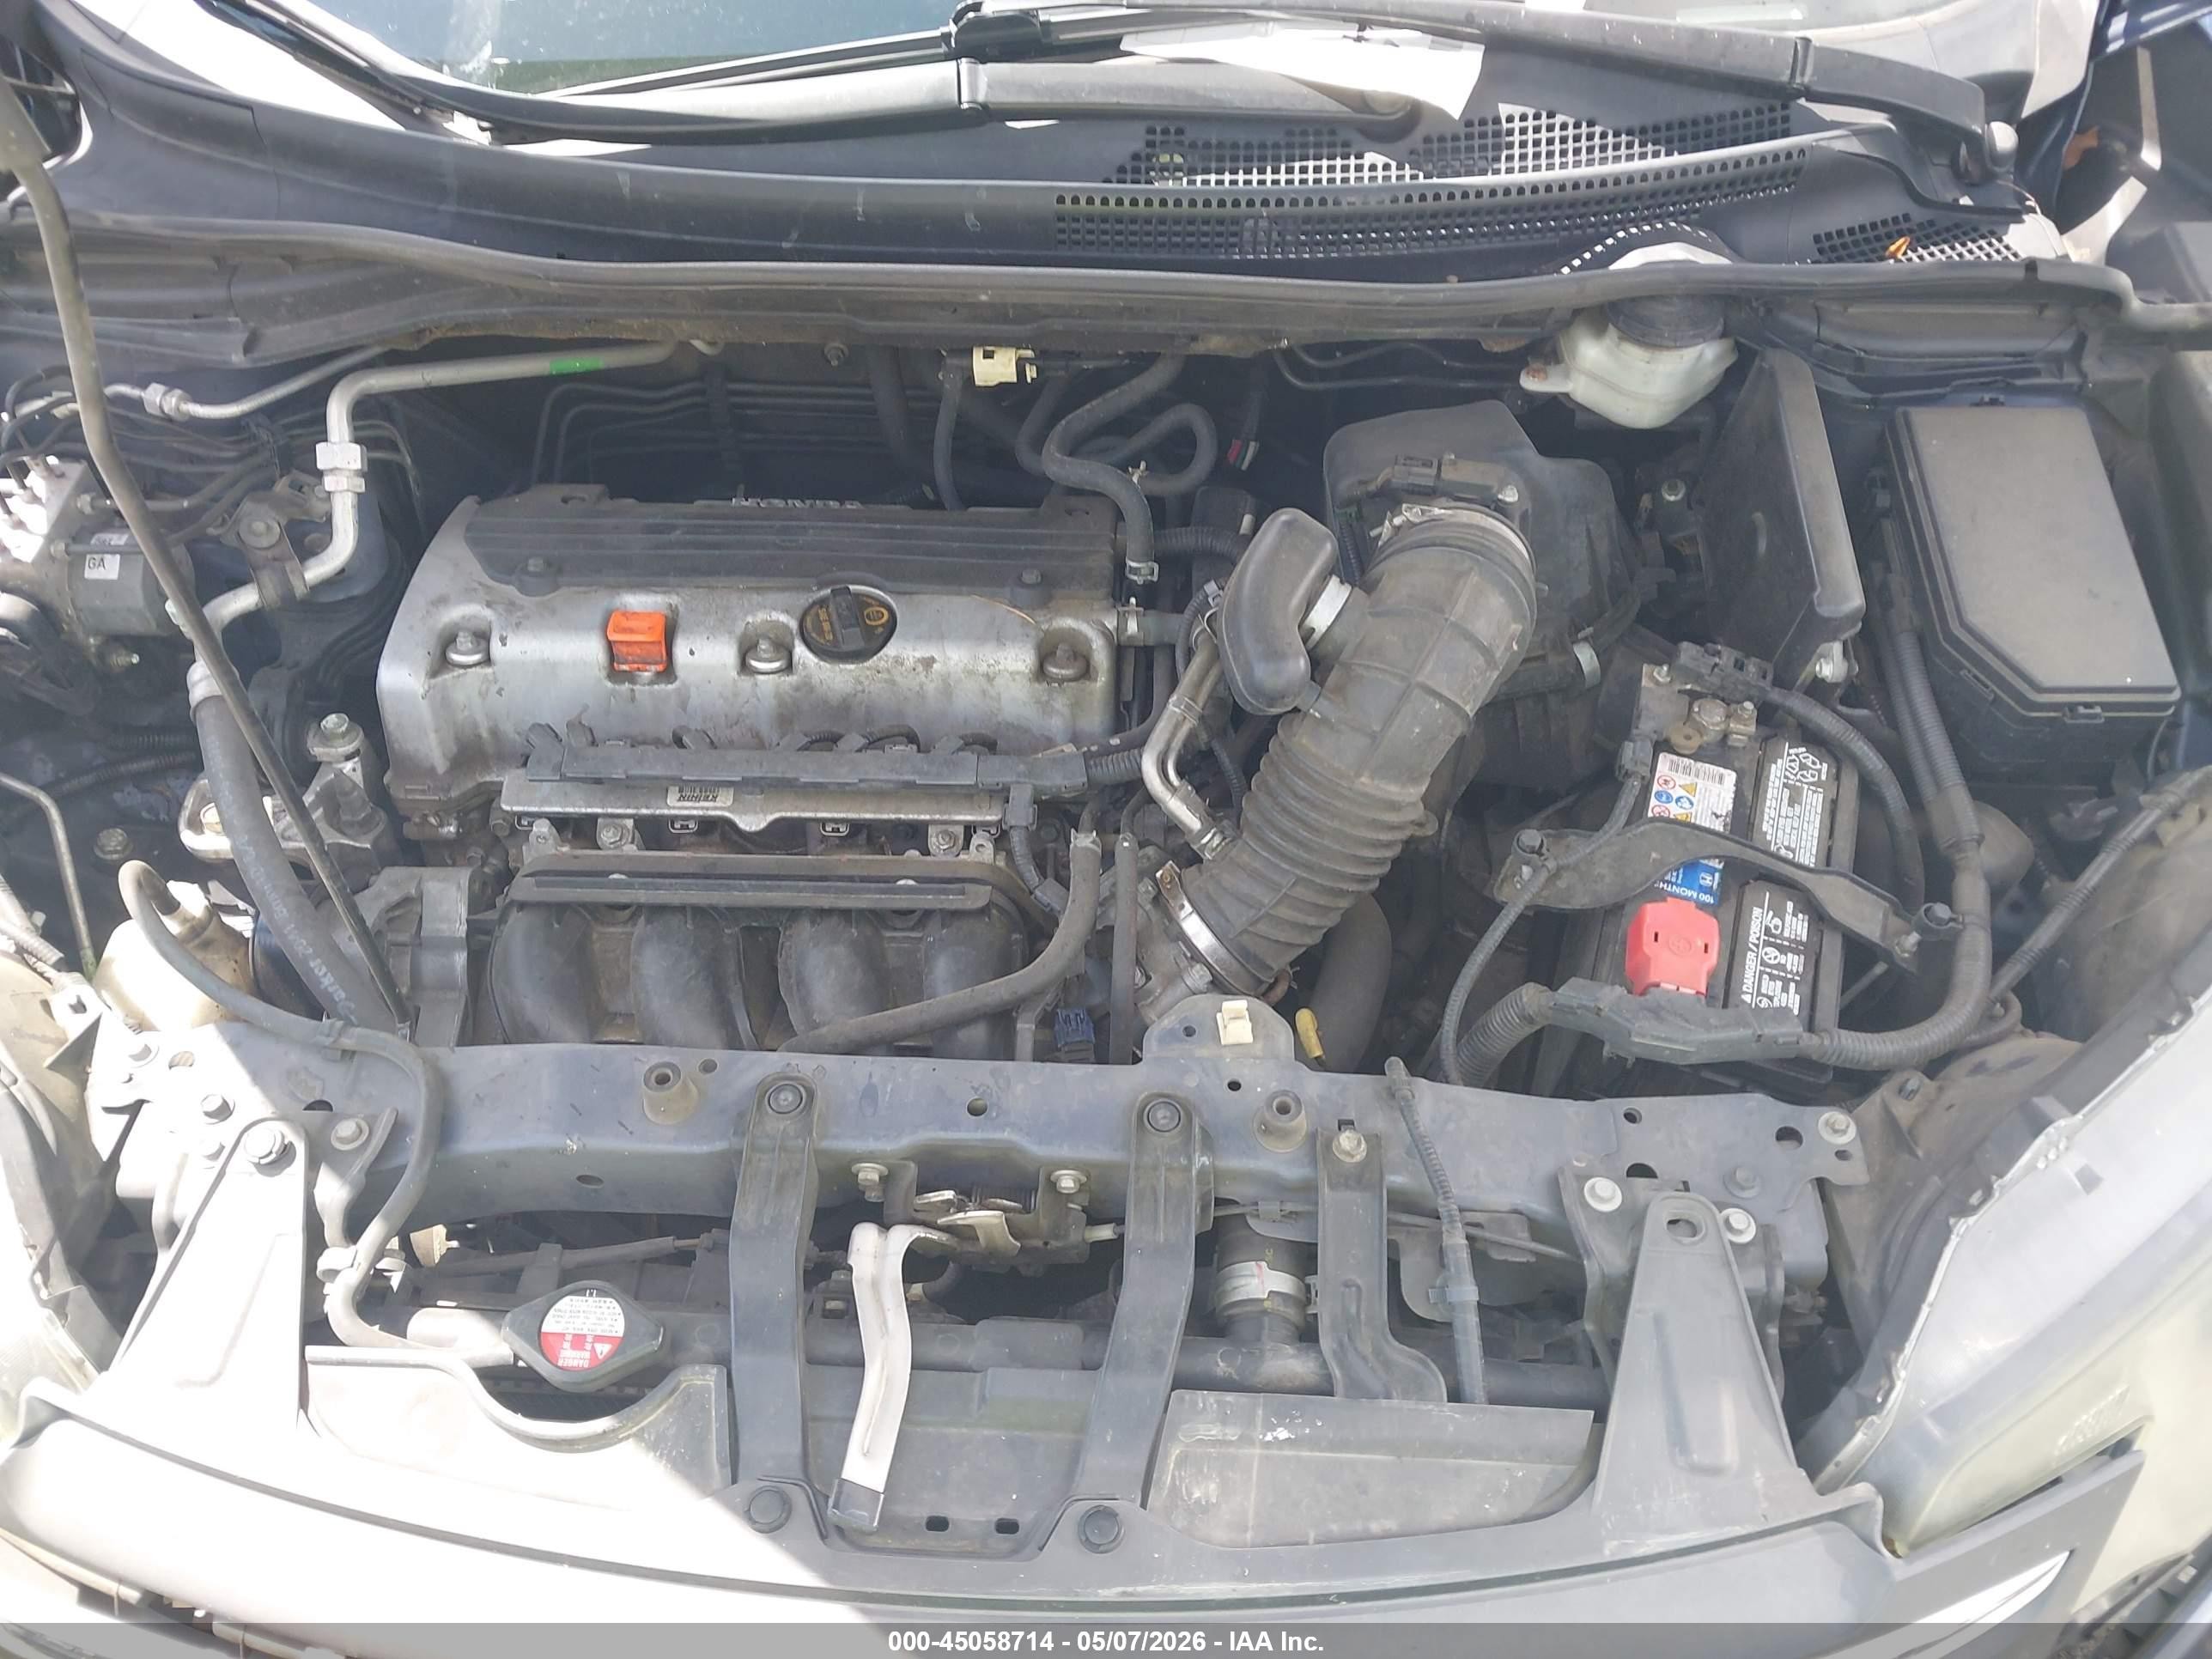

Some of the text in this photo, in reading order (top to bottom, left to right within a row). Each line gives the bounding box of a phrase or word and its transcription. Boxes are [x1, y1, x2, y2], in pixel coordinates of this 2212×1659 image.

[88, 556, 106, 570] GA
[1655, 879, 1698, 899] MONTH
[1698, 892, 1714, 903] 100
[1749, 906, 1763, 944] POISON
[1742, 951, 1757, 994] DANGER
